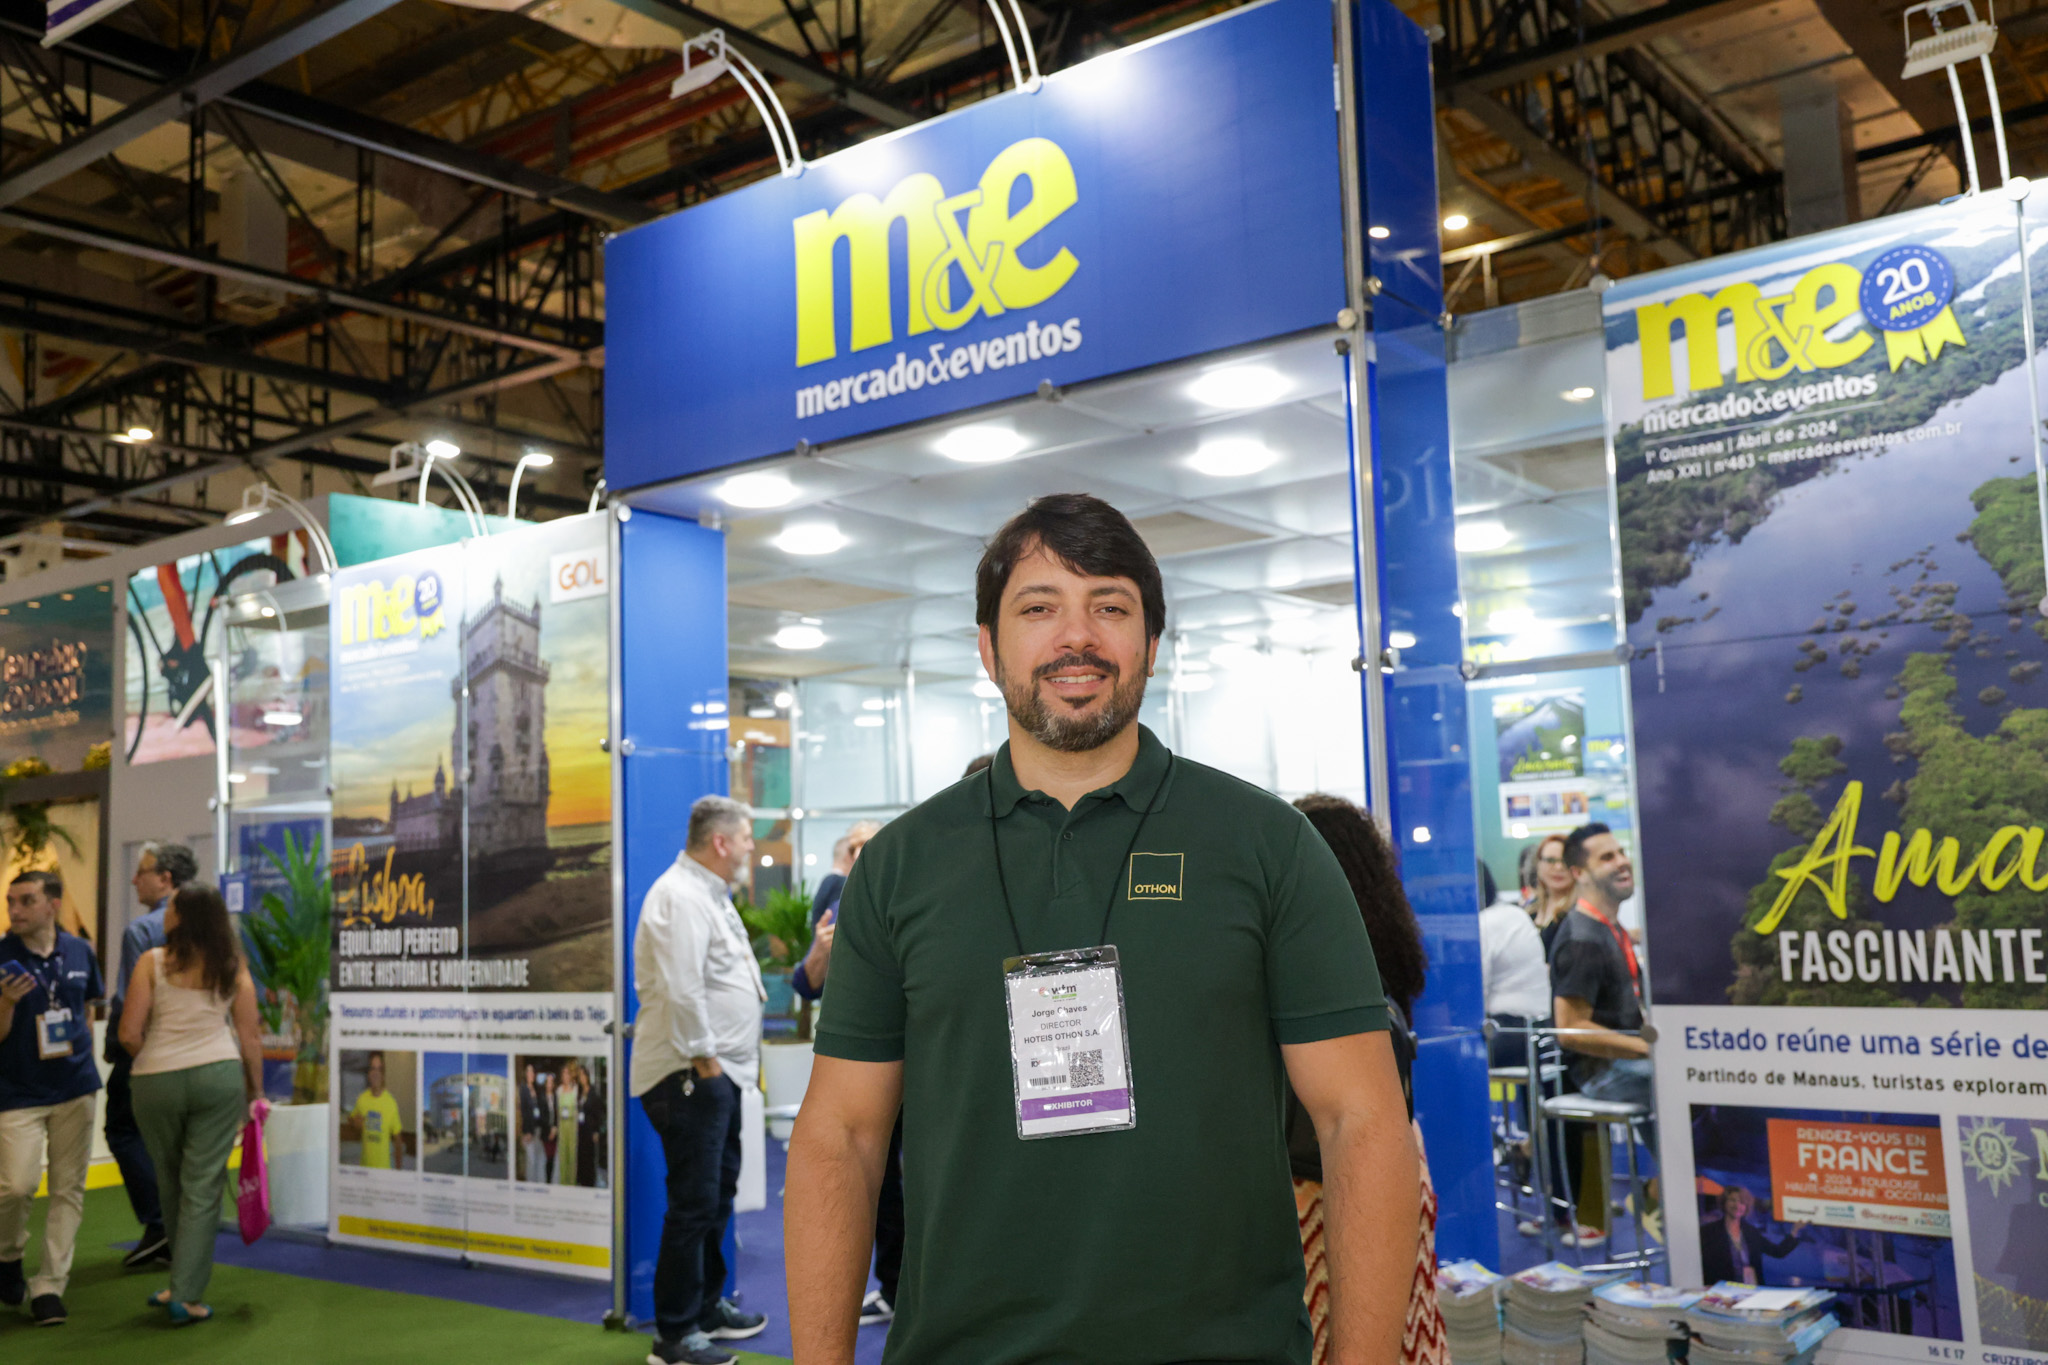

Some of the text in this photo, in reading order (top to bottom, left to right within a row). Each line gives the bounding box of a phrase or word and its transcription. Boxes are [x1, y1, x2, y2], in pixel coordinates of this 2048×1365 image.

[793, 138, 1080, 367] m&e
[1876, 257, 1931, 305] 20
[1889, 290, 1936, 321] ANOS
[1636, 263, 1874, 401] m&e
[796, 318, 1082, 419] mercado&eventos
[1643, 373, 1878, 434] mercado&eventos
[1658, 438, 1724, 463] Quinzena
[1736, 429, 1770, 451] Abril
[1774, 427, 1795, 444] de
[1798, 419, 1838, 440] 2024
[1646, 466, 1675, 484] Ano
[559, 557, 604, 590] GOL
[417, 576, 438, 602] 20
[1134, 884, 1176, 894] OTHON
[403, 927, 459, 954] PERFEITO
[1778, 929, 2048, 983] FASCINANTE
[339, 960, 374, 987] ENTRE
[430, 960, 438, 986] E
[439, 959, 529, 987] MODERNIDADE
[1032, 1008, 1055, 1018] Jorge
[1041, 1018, 1081, 1031] DIRECTOR
[1024, 1033, 1053, 1045] HOTEIS
[1054, 1030, 1083, 1042] OTHON
[1685, 1026, 2048, 1059] Estado reúne uma série de
[1686, 1067, 1757, 1085] Partindo
[1765, 1070, 1785, 1085] de
[1873, 1074, 1945, 1092] turistas
[1953, 1078, 2047, 1097] exploram
[1796, 1127, 1926, 1147] RENDEZ-VOUS EN
[1797, 1142, 1930, 1176] FRANCE
[1860, 1176, 1921, 1191] TOULOUSE
